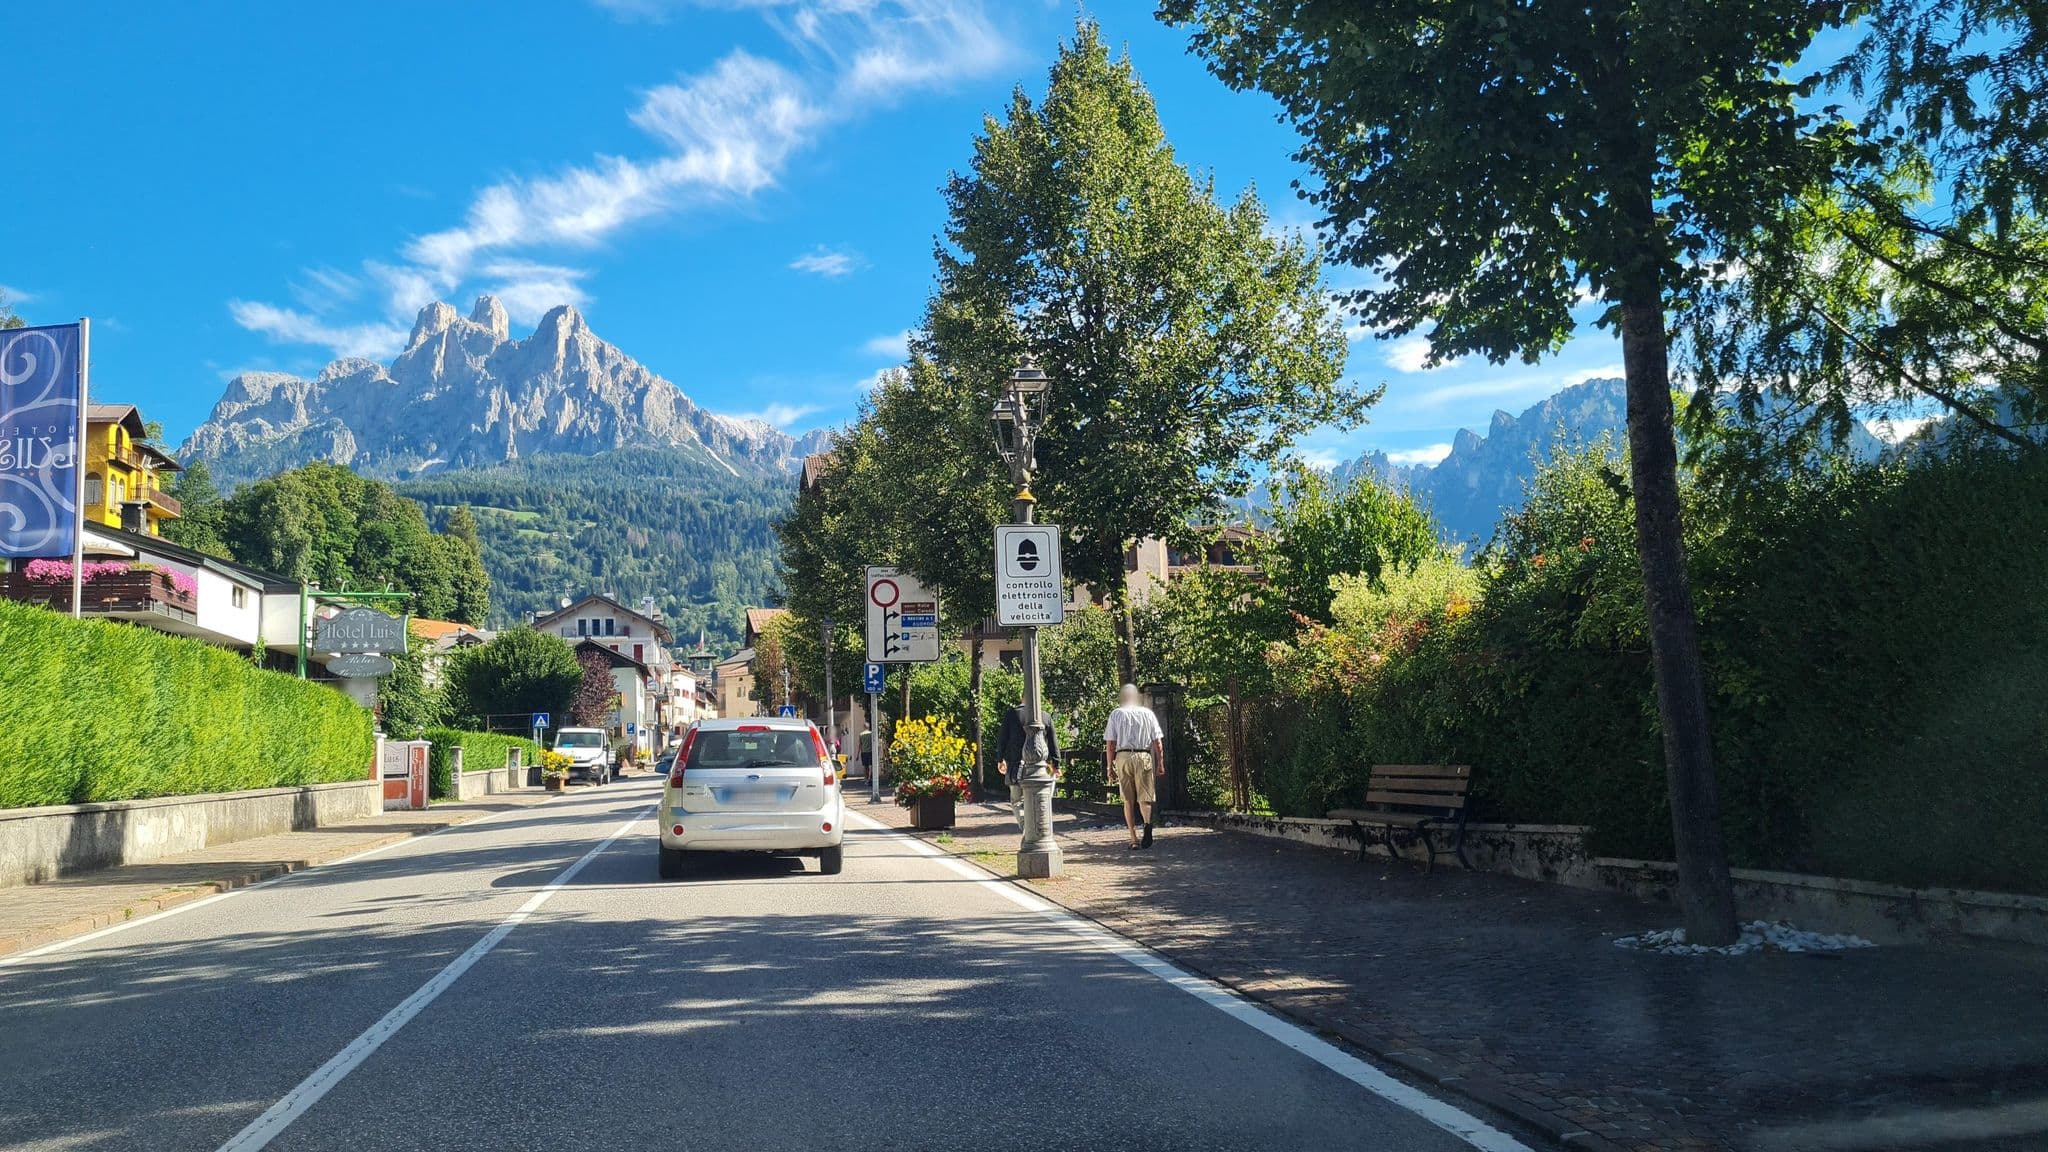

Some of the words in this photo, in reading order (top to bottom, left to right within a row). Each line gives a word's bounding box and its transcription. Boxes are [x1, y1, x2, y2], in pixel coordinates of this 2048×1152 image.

[1006, 581, 1053, 589] controllo
[1002, 591, 1058, 600] elettronico
[1017, 602, 1043, 610] della
[327, 623, 364, 639] Hotel
[370, 623, 395, 639] Luis
[869, 665, 880, 678] P
